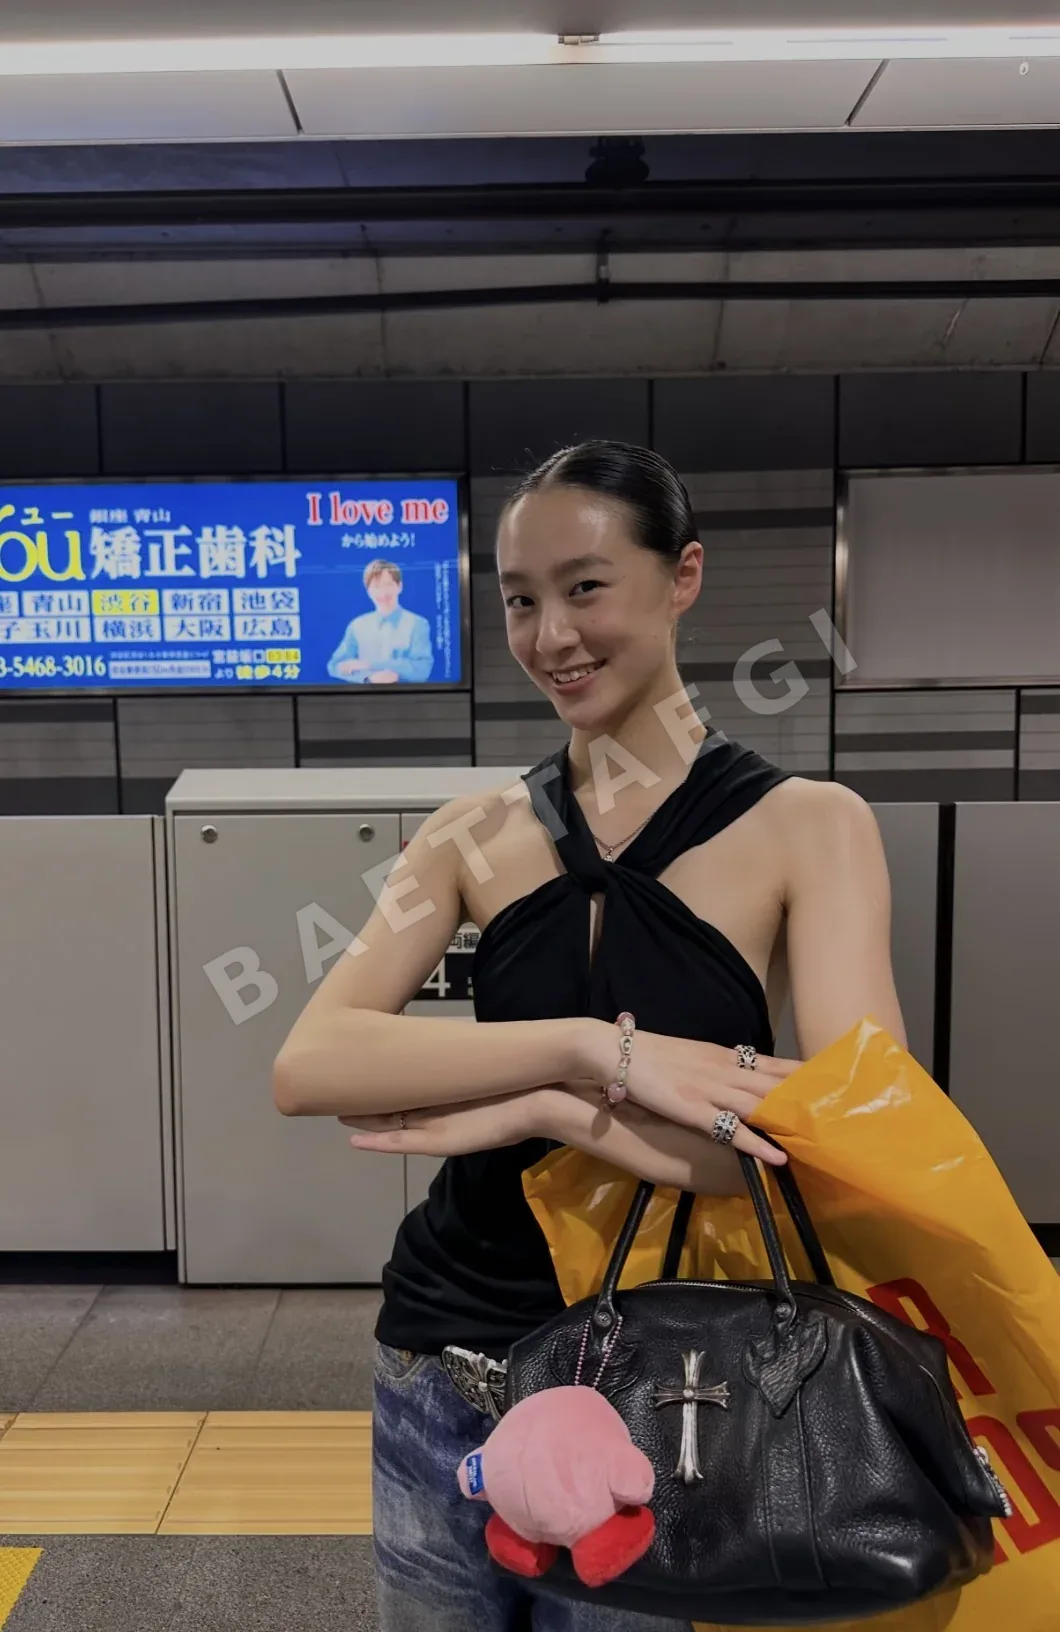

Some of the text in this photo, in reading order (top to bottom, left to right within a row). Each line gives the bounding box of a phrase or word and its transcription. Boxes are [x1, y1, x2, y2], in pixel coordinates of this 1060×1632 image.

[133, 507, 171, 524] 青山
[306, 491, 449, 525] I love me
[90, 524, 302, 580] 矯正歯科
[32, 594, 82, 613] 青山
[101, 594, 151, 612] 渋谷
[171, 592, 222, 612] 新宿
[242, 591, 294, 611] 池袋
[103, 619, 154, 639] 横浜
[174, 618, 224, 637] 大阪
[242, 618, 293, 637] 広島
